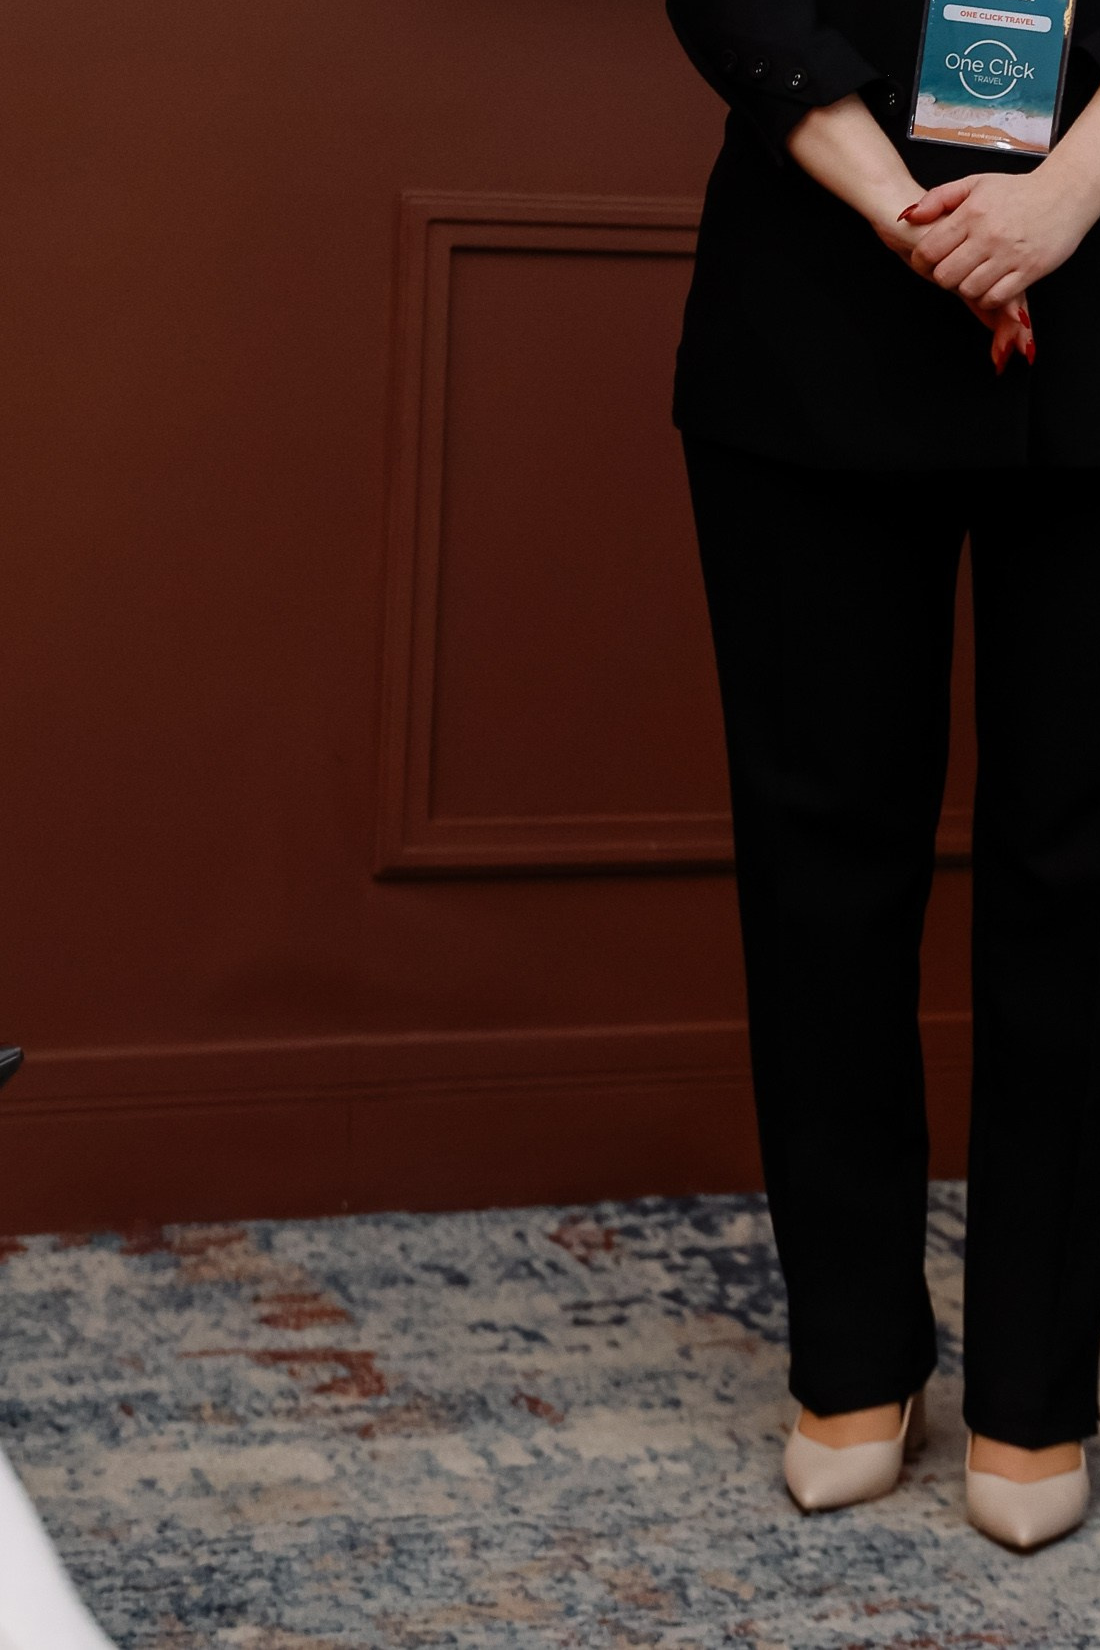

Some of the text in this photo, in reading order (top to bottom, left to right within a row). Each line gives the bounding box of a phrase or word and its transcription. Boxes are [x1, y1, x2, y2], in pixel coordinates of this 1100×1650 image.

[960, 10, 1035, 26] ONE CLICK TRAVEL
[945, 53, 1035, 79] One Click
[973, 74, 1003, 85] TRAVEL
